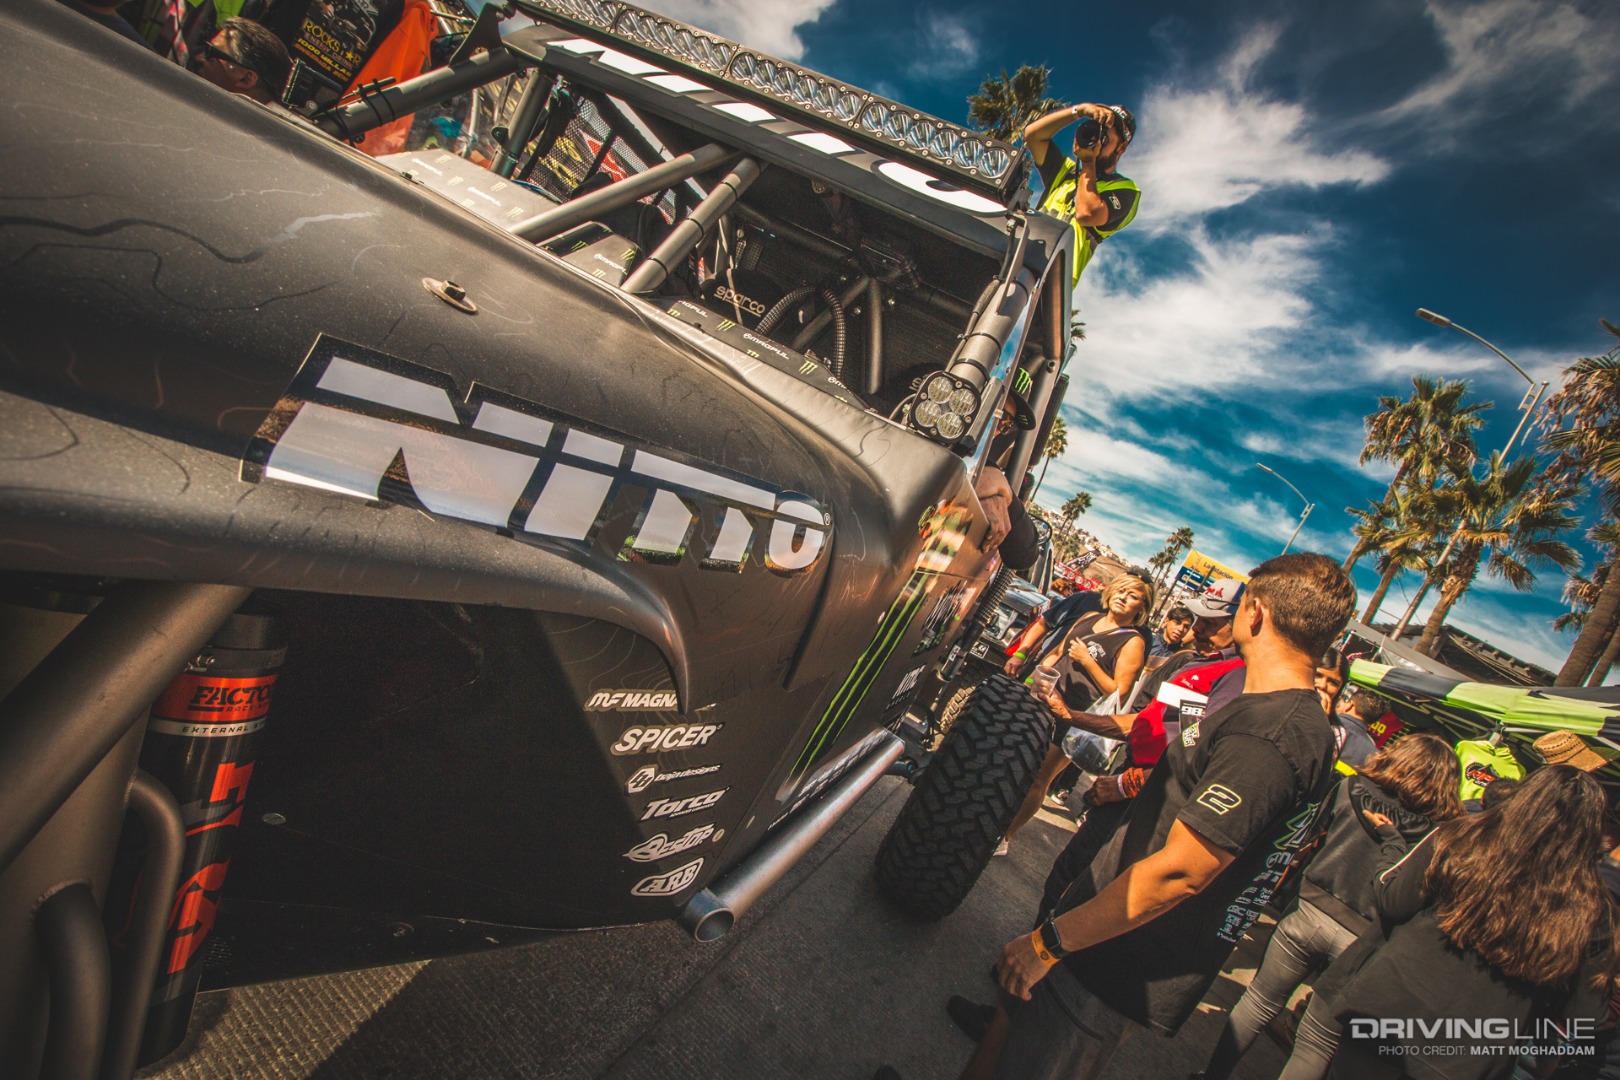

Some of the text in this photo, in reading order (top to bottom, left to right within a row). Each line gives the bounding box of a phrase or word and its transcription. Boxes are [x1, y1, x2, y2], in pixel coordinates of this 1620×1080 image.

[297, 37, 321, 55] 1000
[715, 285, 766, 315] sparco
[749, 336, 790, 360] MAGPUL
[182, 725, 249, 734] EXTERNAL
[614, 725, 717, 752] SPICER
[1197, 784, 1242, 815] 2
[637, 863, 700, 893] ARB
